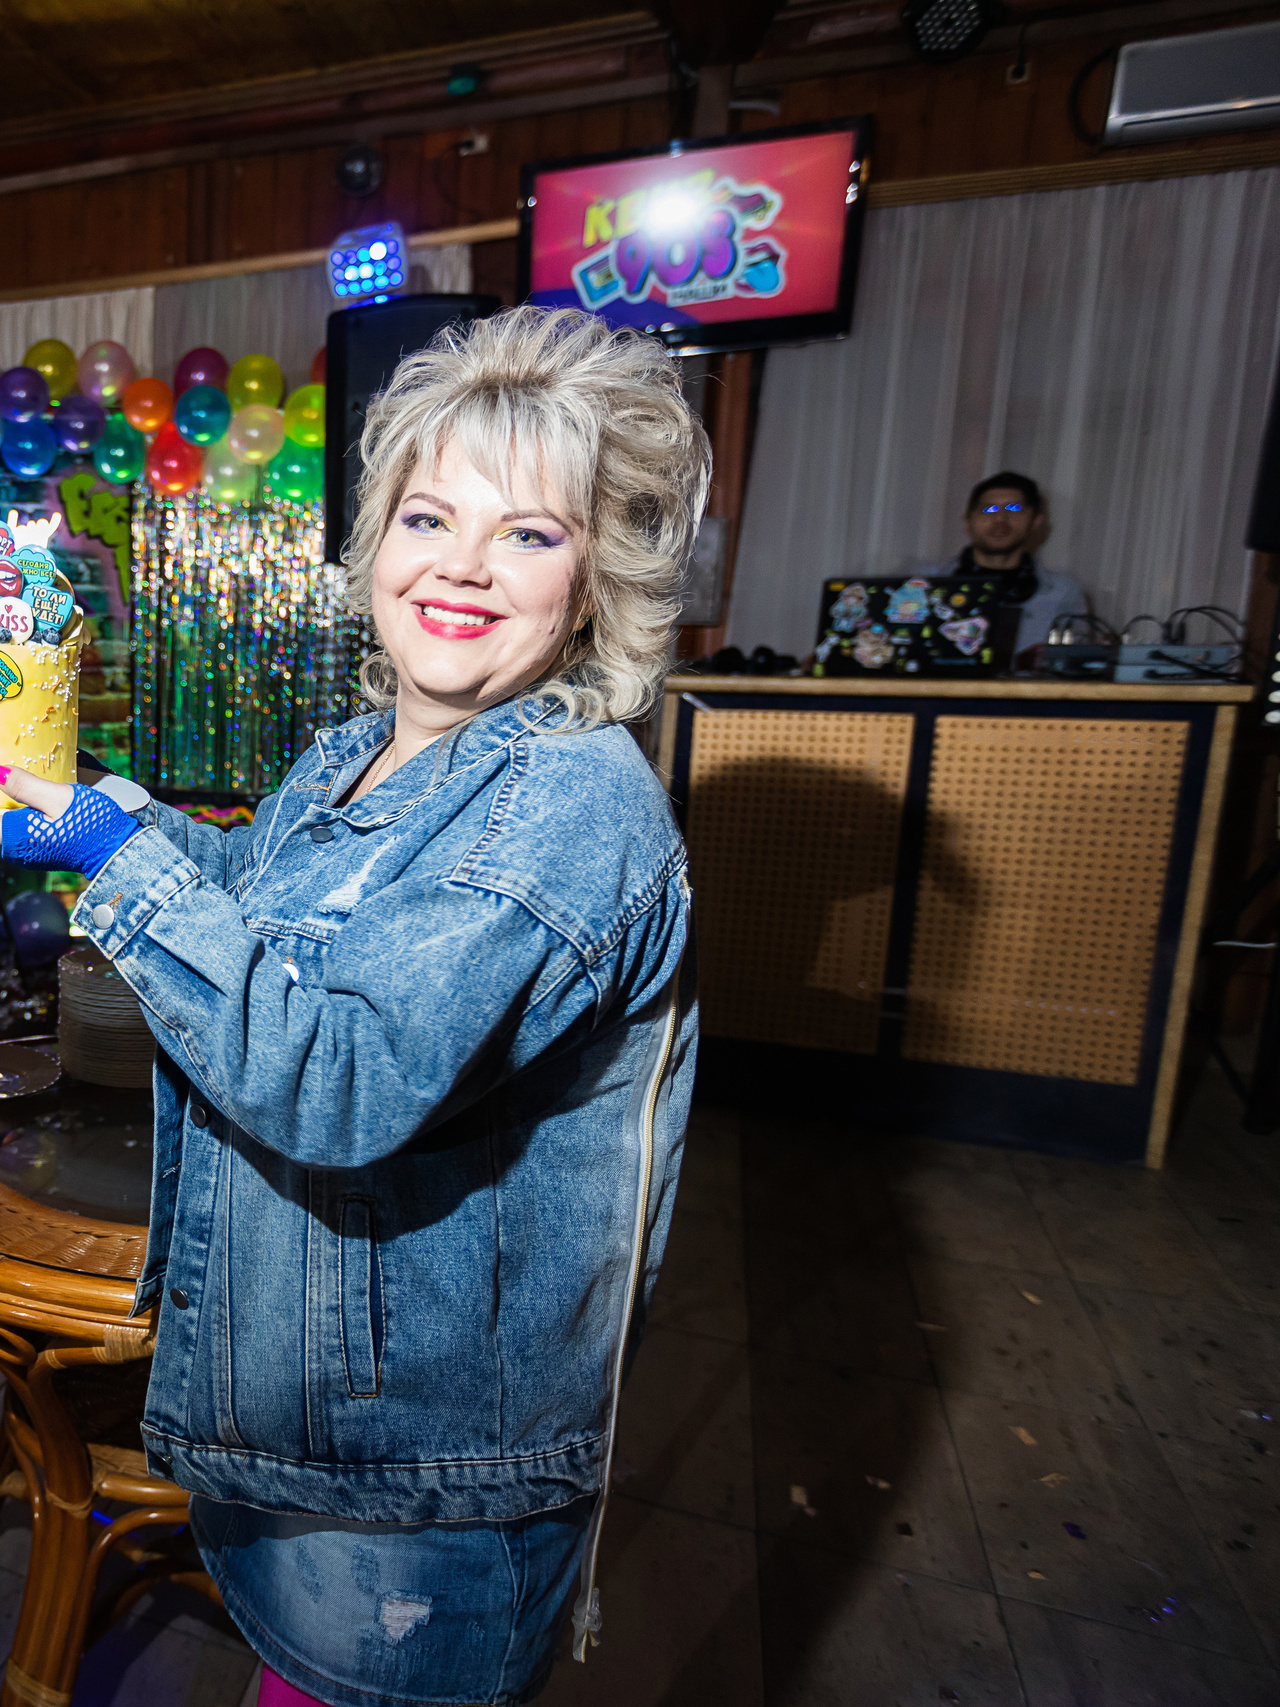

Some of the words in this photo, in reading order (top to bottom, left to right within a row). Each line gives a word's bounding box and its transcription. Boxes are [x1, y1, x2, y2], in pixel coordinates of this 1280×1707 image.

[18, 559, 49, 570] СЕГОДНЯ
[22, 568, 39, 576] ЖНО
[32, 586, 48, 598] ТО
[49, 592, 67, 605] ЛИ
[32, 607, 64, 626] УДЕТ!
